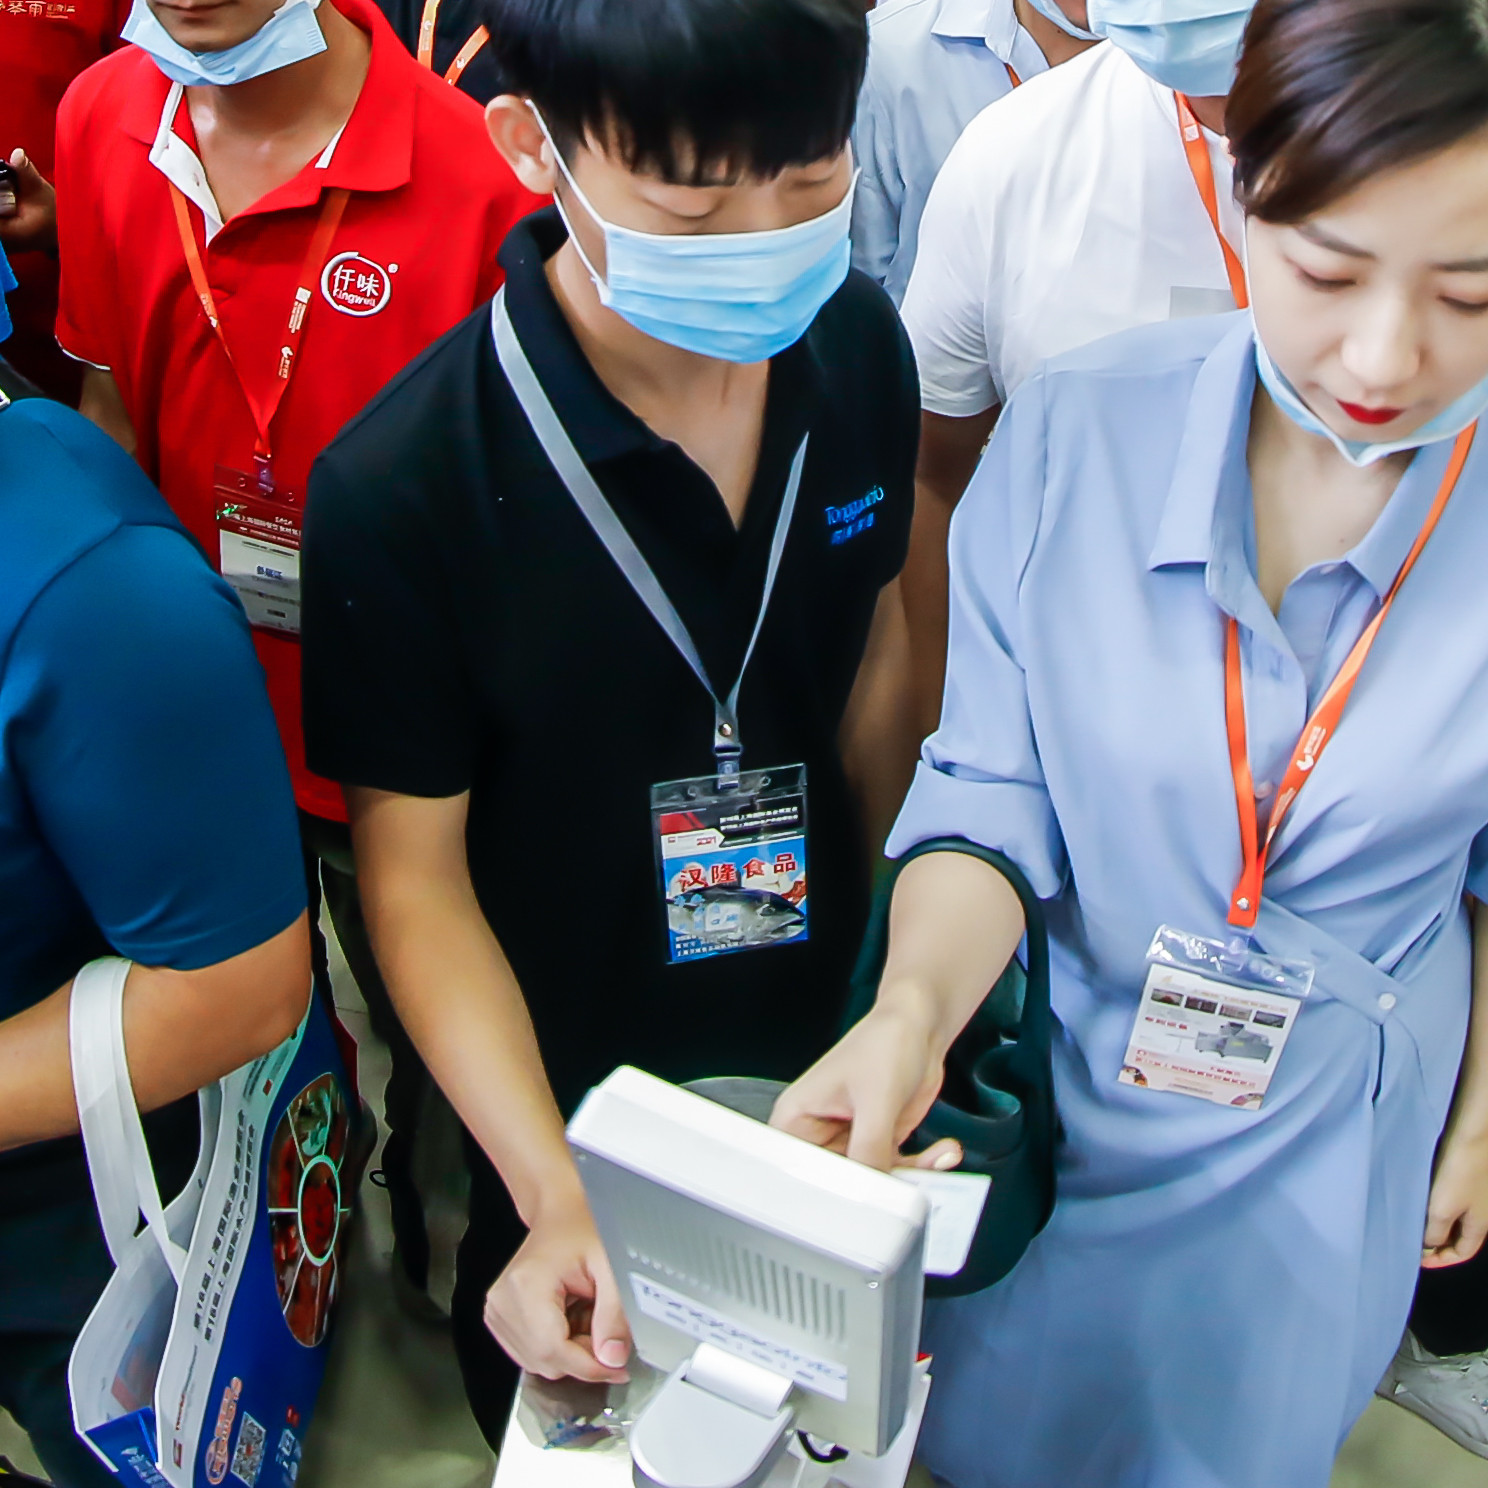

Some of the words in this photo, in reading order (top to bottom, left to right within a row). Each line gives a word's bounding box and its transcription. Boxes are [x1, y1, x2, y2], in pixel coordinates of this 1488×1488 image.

[333, 264, 380, 298] 仟味
[680, 853, 796, 892] 汉隆食品
